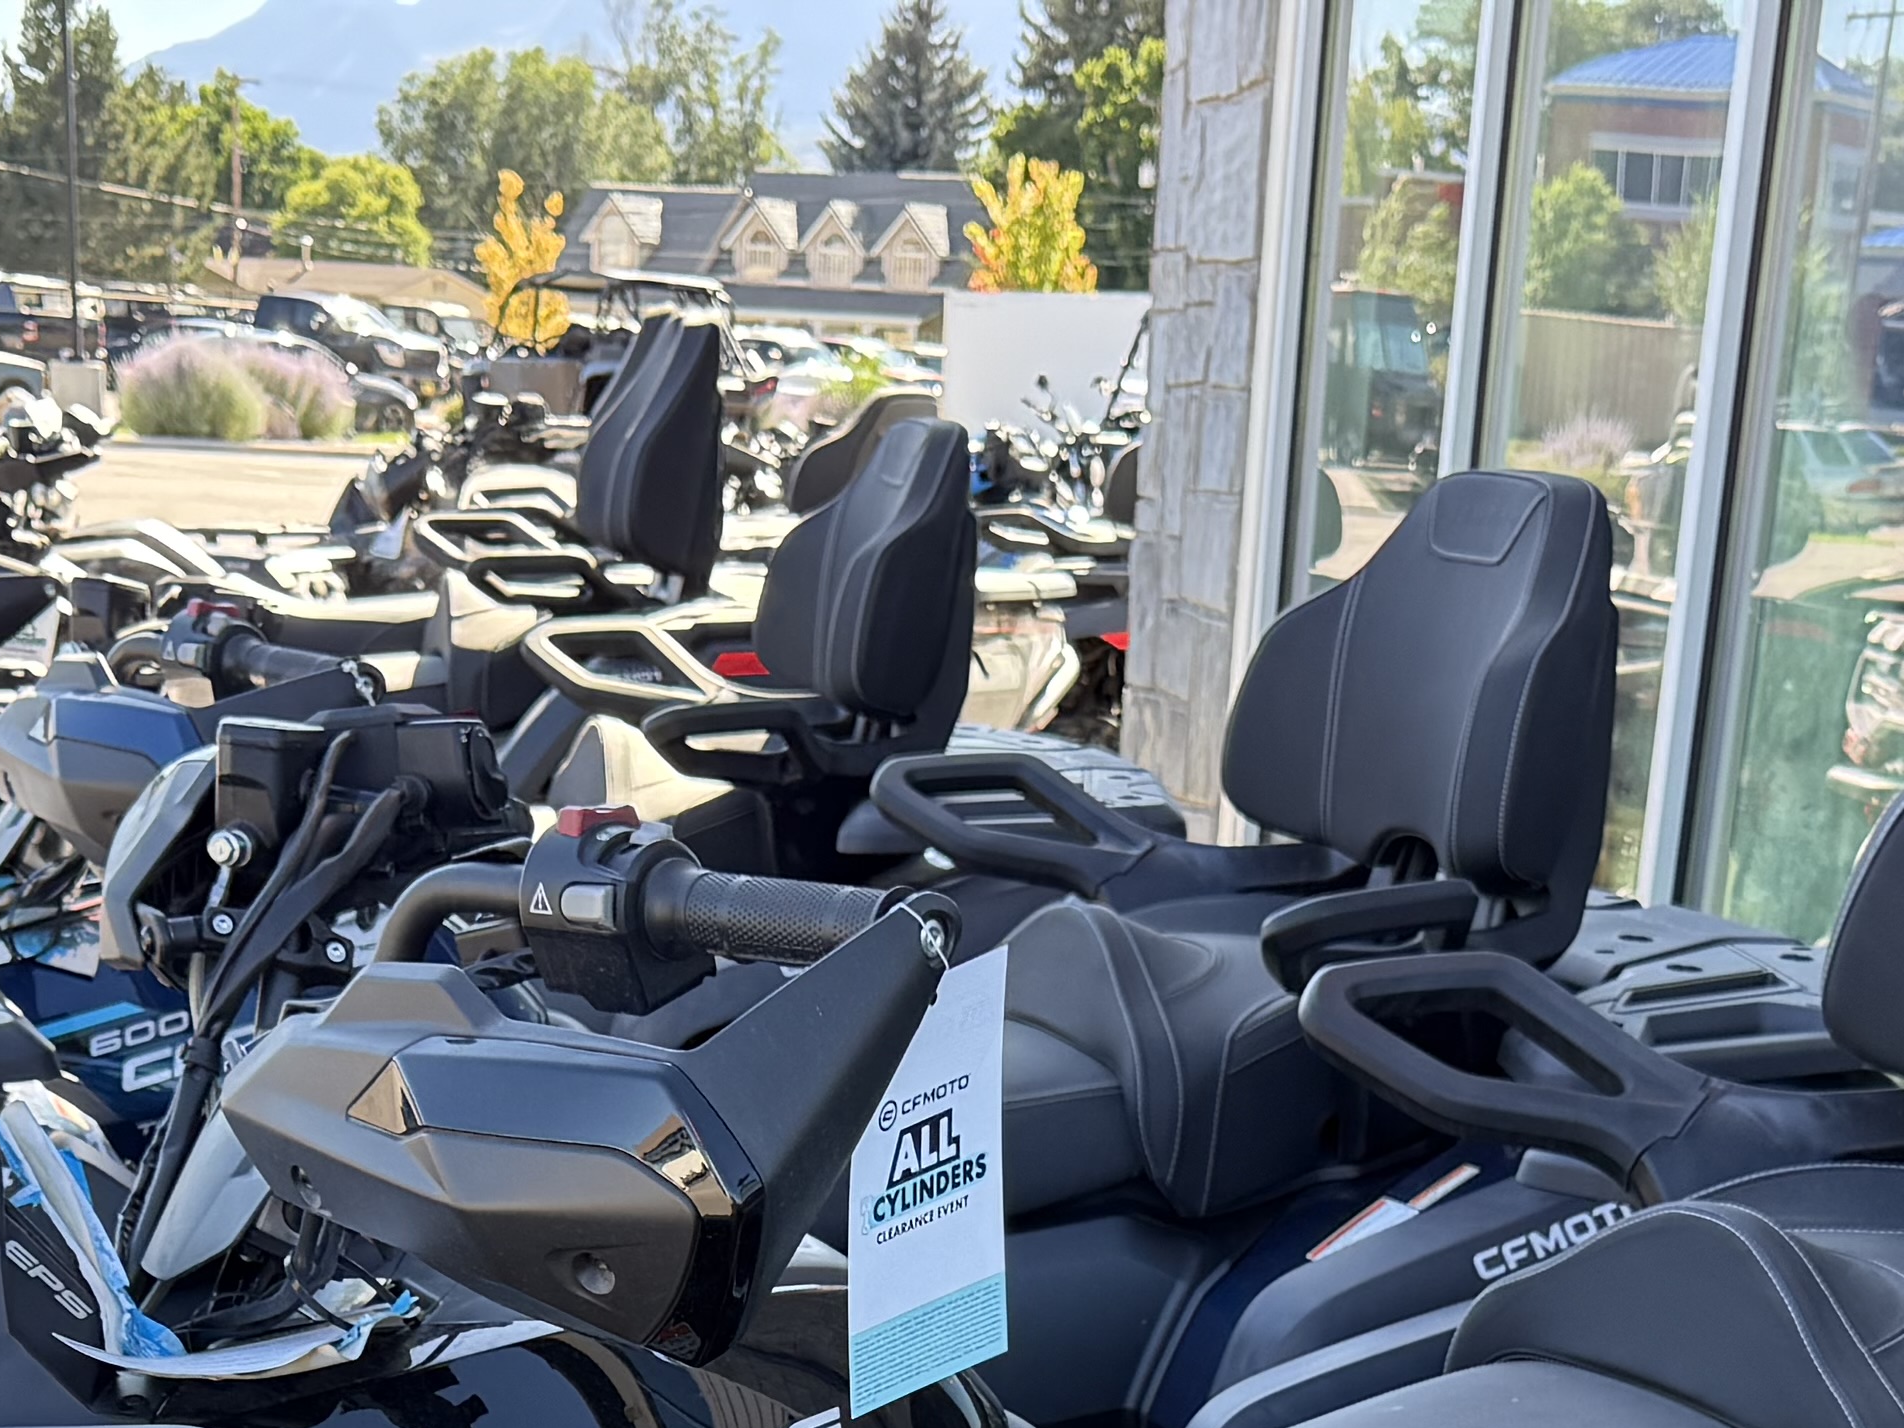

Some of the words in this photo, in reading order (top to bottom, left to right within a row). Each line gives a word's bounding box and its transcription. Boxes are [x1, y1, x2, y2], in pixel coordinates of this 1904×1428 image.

[89, 1010, 189, 1057] 600
[901, 1074, 969, 1115] CFMOTO
[887, 1109, 960, 1188] ALL
[873, 1153, 987, 1223] CYLINDERS
[876, 1210, 935, 1245] CLEARANCE
[937, 1195, 969, 1220] EVENT
[5, 1240, 94, 1320] EPS
